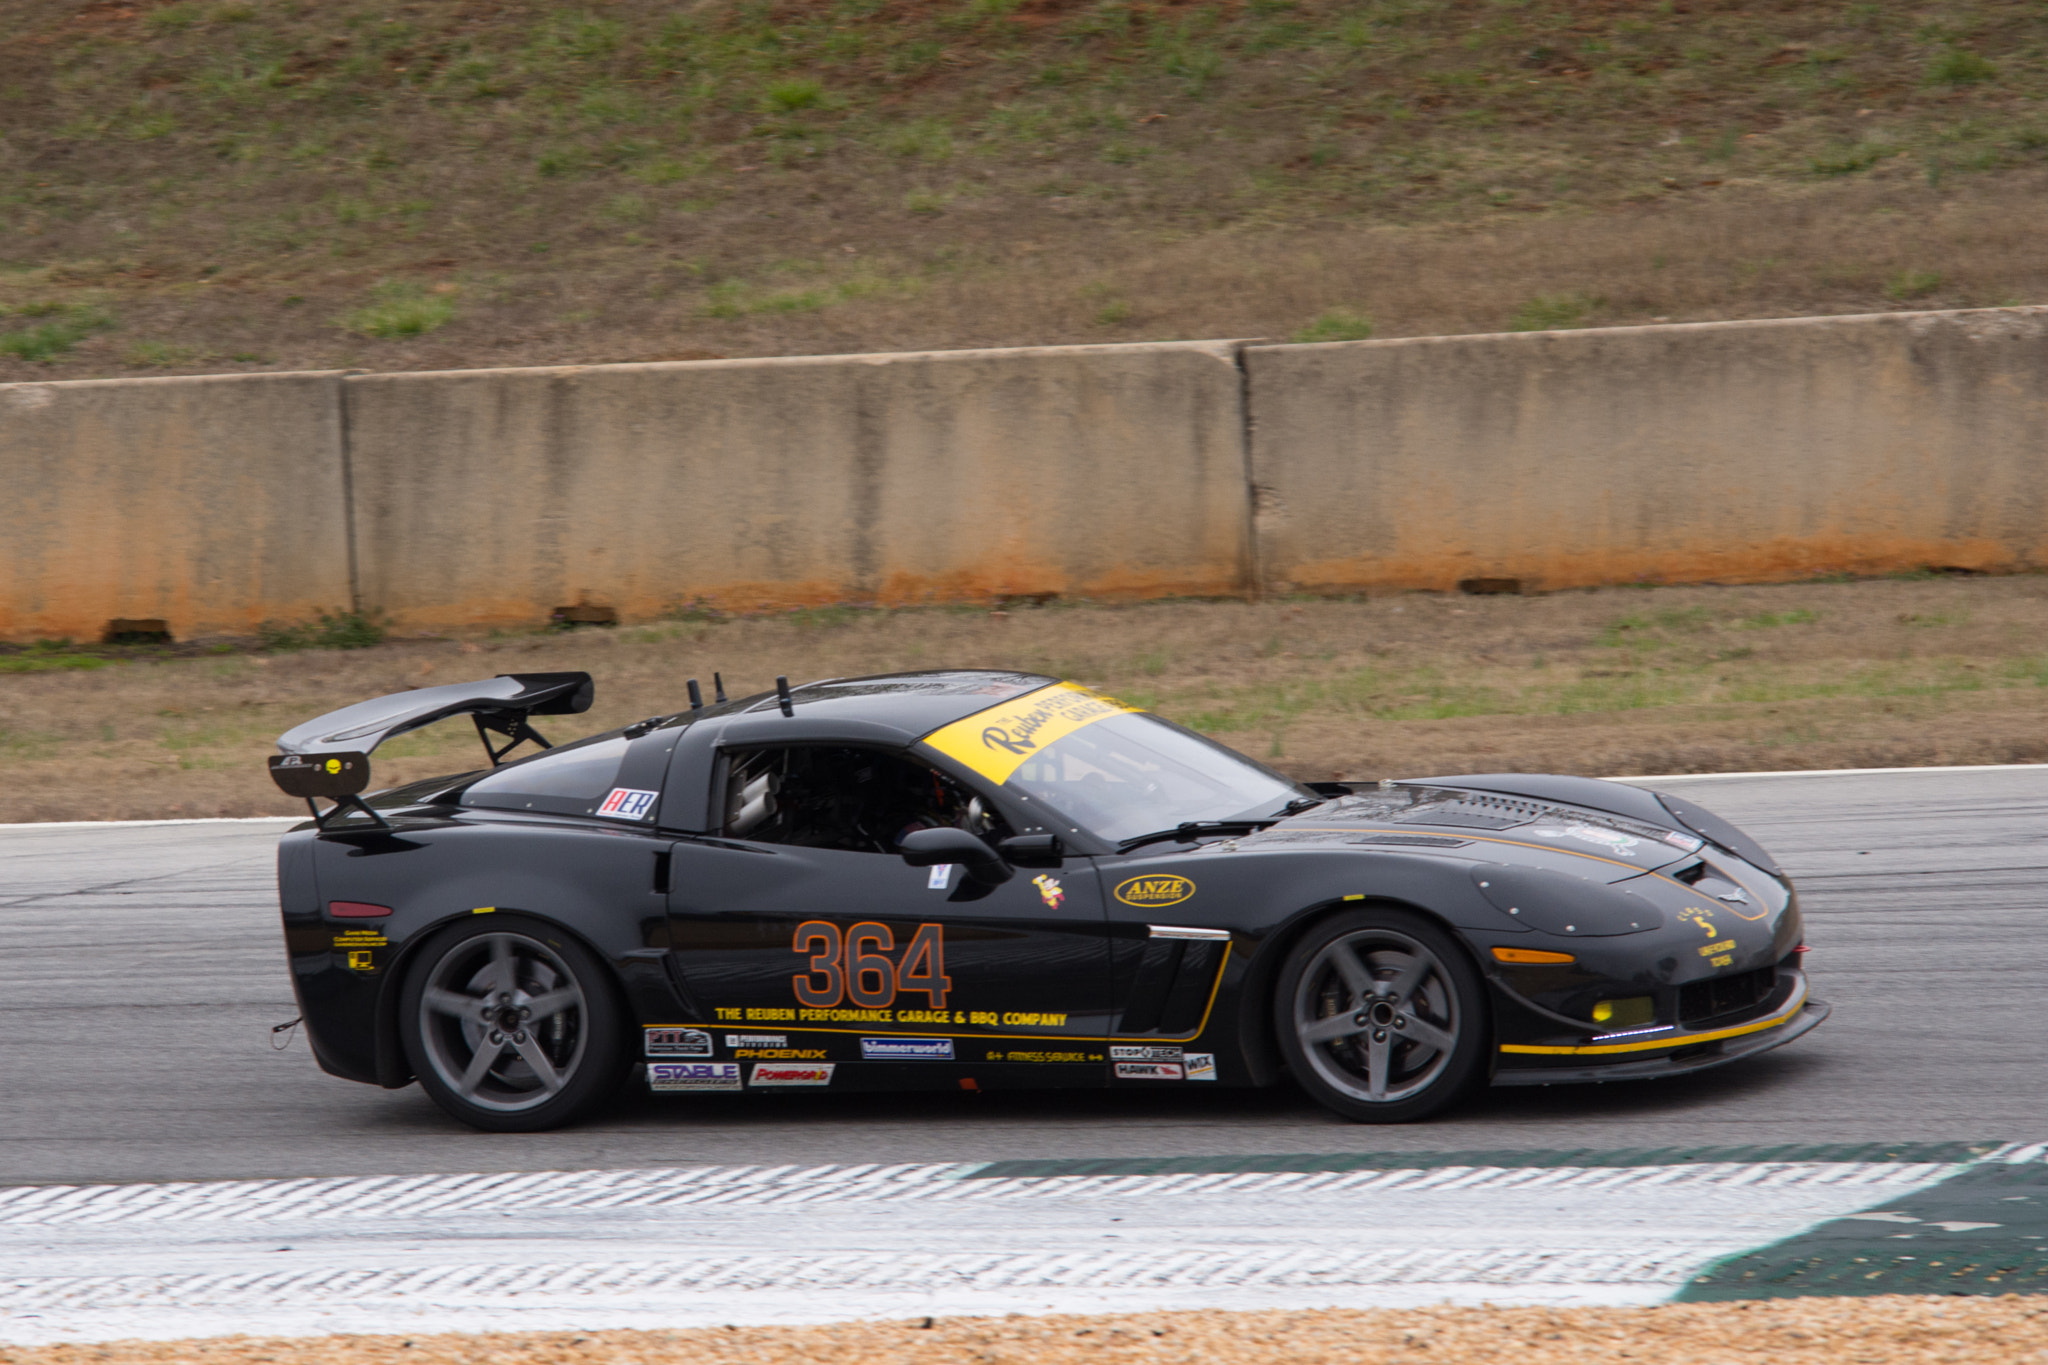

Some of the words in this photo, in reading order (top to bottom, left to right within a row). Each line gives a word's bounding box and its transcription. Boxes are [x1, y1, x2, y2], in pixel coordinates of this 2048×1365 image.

[981, 706, 1055, 755] Reuben
[602, 790, 655, 815] AER
[1126, 880, 1186, 895] ANZE
[792, 920, 953, 1009] 364
[714, 1007, 743, 1021] THE
[746, 1008, 796, 1021] REUBEN
[799, 1009, 893, 1023] PERFORMANCE
[896, 1010, 950, 1024] GARAGE
[953, 1011, 967, 1024] &
[969, 1011, 999, 1026] BBQ
[1002, 1012, 1068, 1026] COMPANY
[734, 1049, 828, 1059] PHOENIX
[863, 1041, 951, 1054] bimmerworld
[653, 1065, 737, 1079] STABLE
[1118, 1064, 1159, 1075] HAWK
